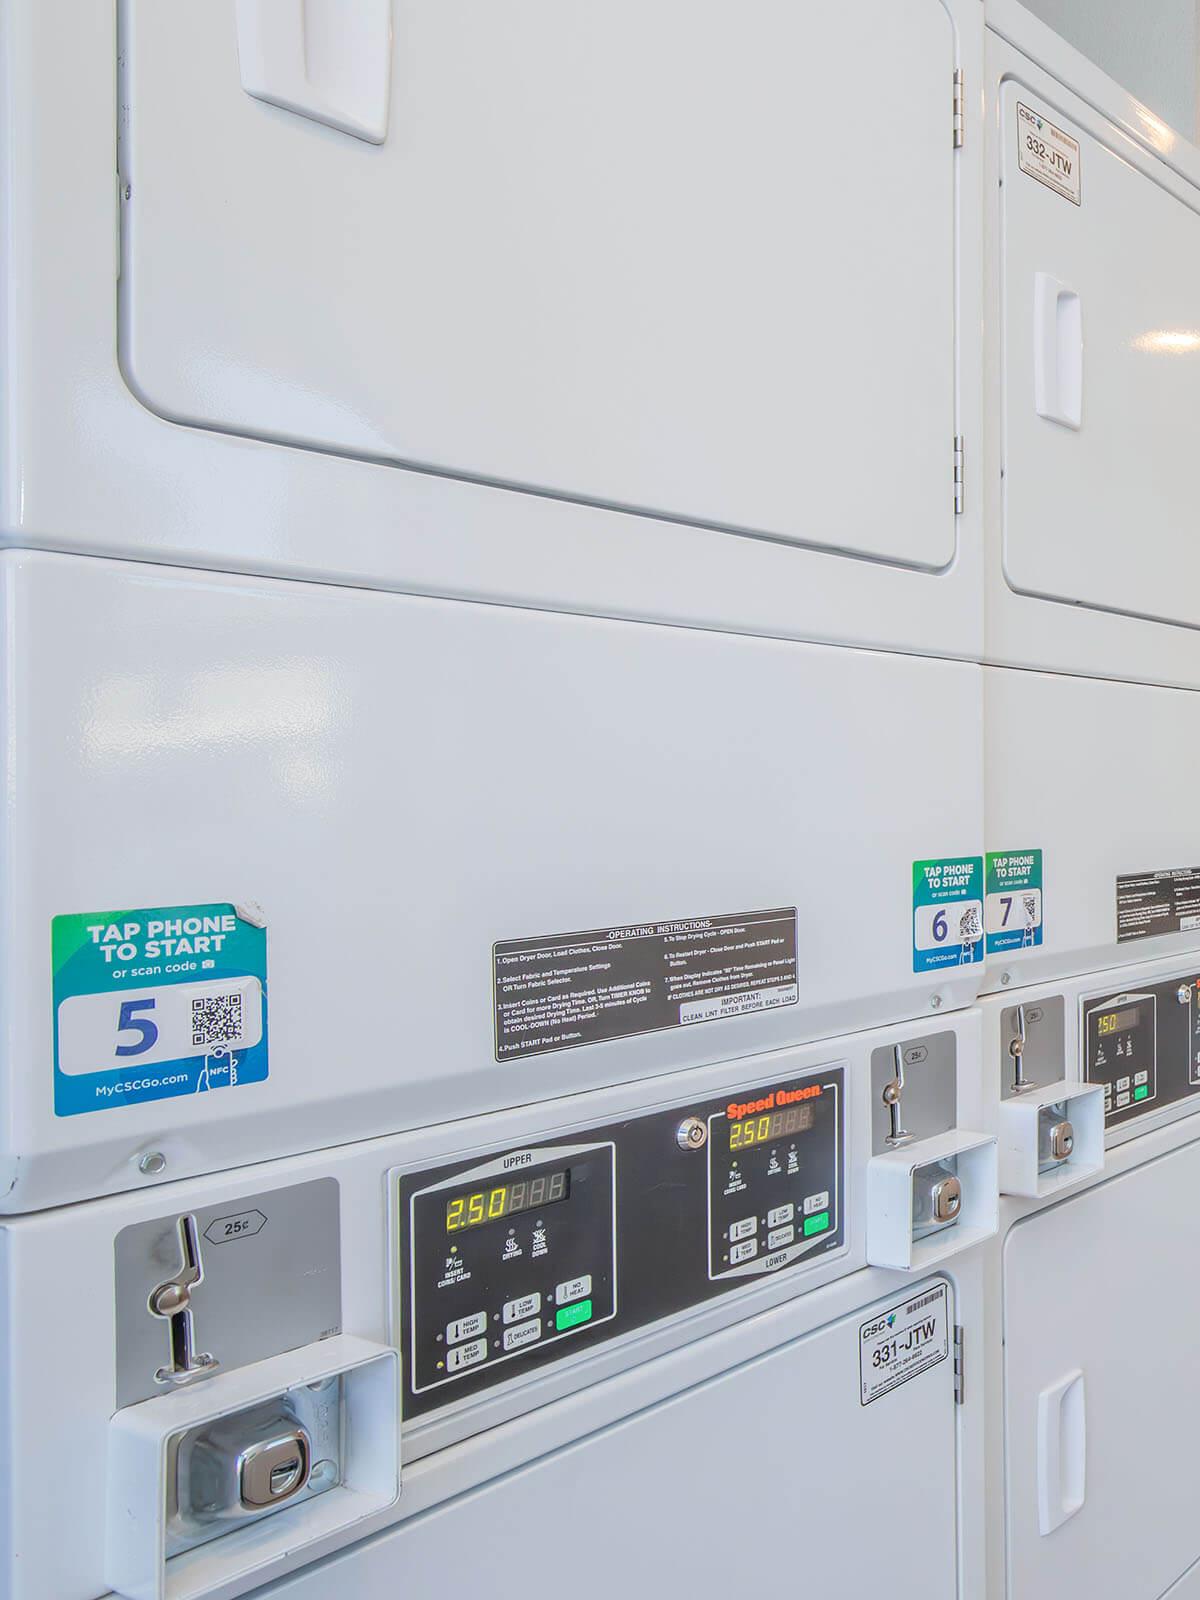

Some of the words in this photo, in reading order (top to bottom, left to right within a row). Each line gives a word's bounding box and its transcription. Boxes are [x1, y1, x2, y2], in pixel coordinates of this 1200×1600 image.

[1019, 109, 1036, 124] CSC
[1026, 135, 1072, 175] 332-JTW
[993, 858, 1007, 868] TAP
[1008, 856, 1034, 866] PHONE
[924, 867, 941, 877] TAP
[943, 864, 974, 874] PHONE
[997, 869, 1007, 877] TO
[1008, 866, 1031, 877] START
[928, 878, 941, 888] TO
[943, 875, 970, 887] START
[1000, 897, 1012, 927] 7
[88, 922, 140, 944] TAP
[147, 914, 237, 939] PHONE
[932, 909, 948, 942] 6
[99, 943, 137, 963] TO
[144, 935, 227, 959] START
[112, 968, 128, 978] or
[131, 965, 162, 977] scan
[165, 960, 197, 974] code
[553, 966, 587, 976] Temperature
[528, 980, 545, 988] Fabric
[722, 992, 761, 1005] IMPORTANT:
[683, 1013, 702, 1021] CLEAN
[720, 1006, 739, 1015] FILTER
[742, 1000, 763, 1010] BEFORE
[766, 998, 779, 1006] EACH
[782, 995, 796, 1003] LOAD
[114, 997, 159, 1057] 5
[511, 1020, 549, 1032] COOL-DOWN
[520, 1039, 541, 1048] START
[542, 1036, 553, 1044] Pad
[209, 1066, 229, 1076] NFC
[95, 1072, 189, 1098] MyCSCGo.com
[727, 1093, 774, 1119] Speed
[776, 1085, 821, 1105] Queen
[503, 1153, 532, 1169] UPPER
[447, 1188, 506, 1230] 2.50
[533, 1242, 546, 1250] COOL
[766, 1253, 787, 1268] LOWER
[445, 1268, 464, 1278] INSERT
[457, 1272, 471, 1282] CARD
[570, 1287, 584, 1296] HEAT
[518, 1305, 534, 1314] TEMP
[519, 1299, 532, 1308] LOW
[463, 1318, 478, 1327] HIGH
[463, 1325, 480, 1335] TEMP
[514, 1327, 537, 1340] DELICATES
[863, 1320, 886, 1339] CSC
[464, 1344, 478, 1353] MED
[872, 1318, 936, 1367] 331-JTW
[463, 1350, 480, 1360] TEMP
